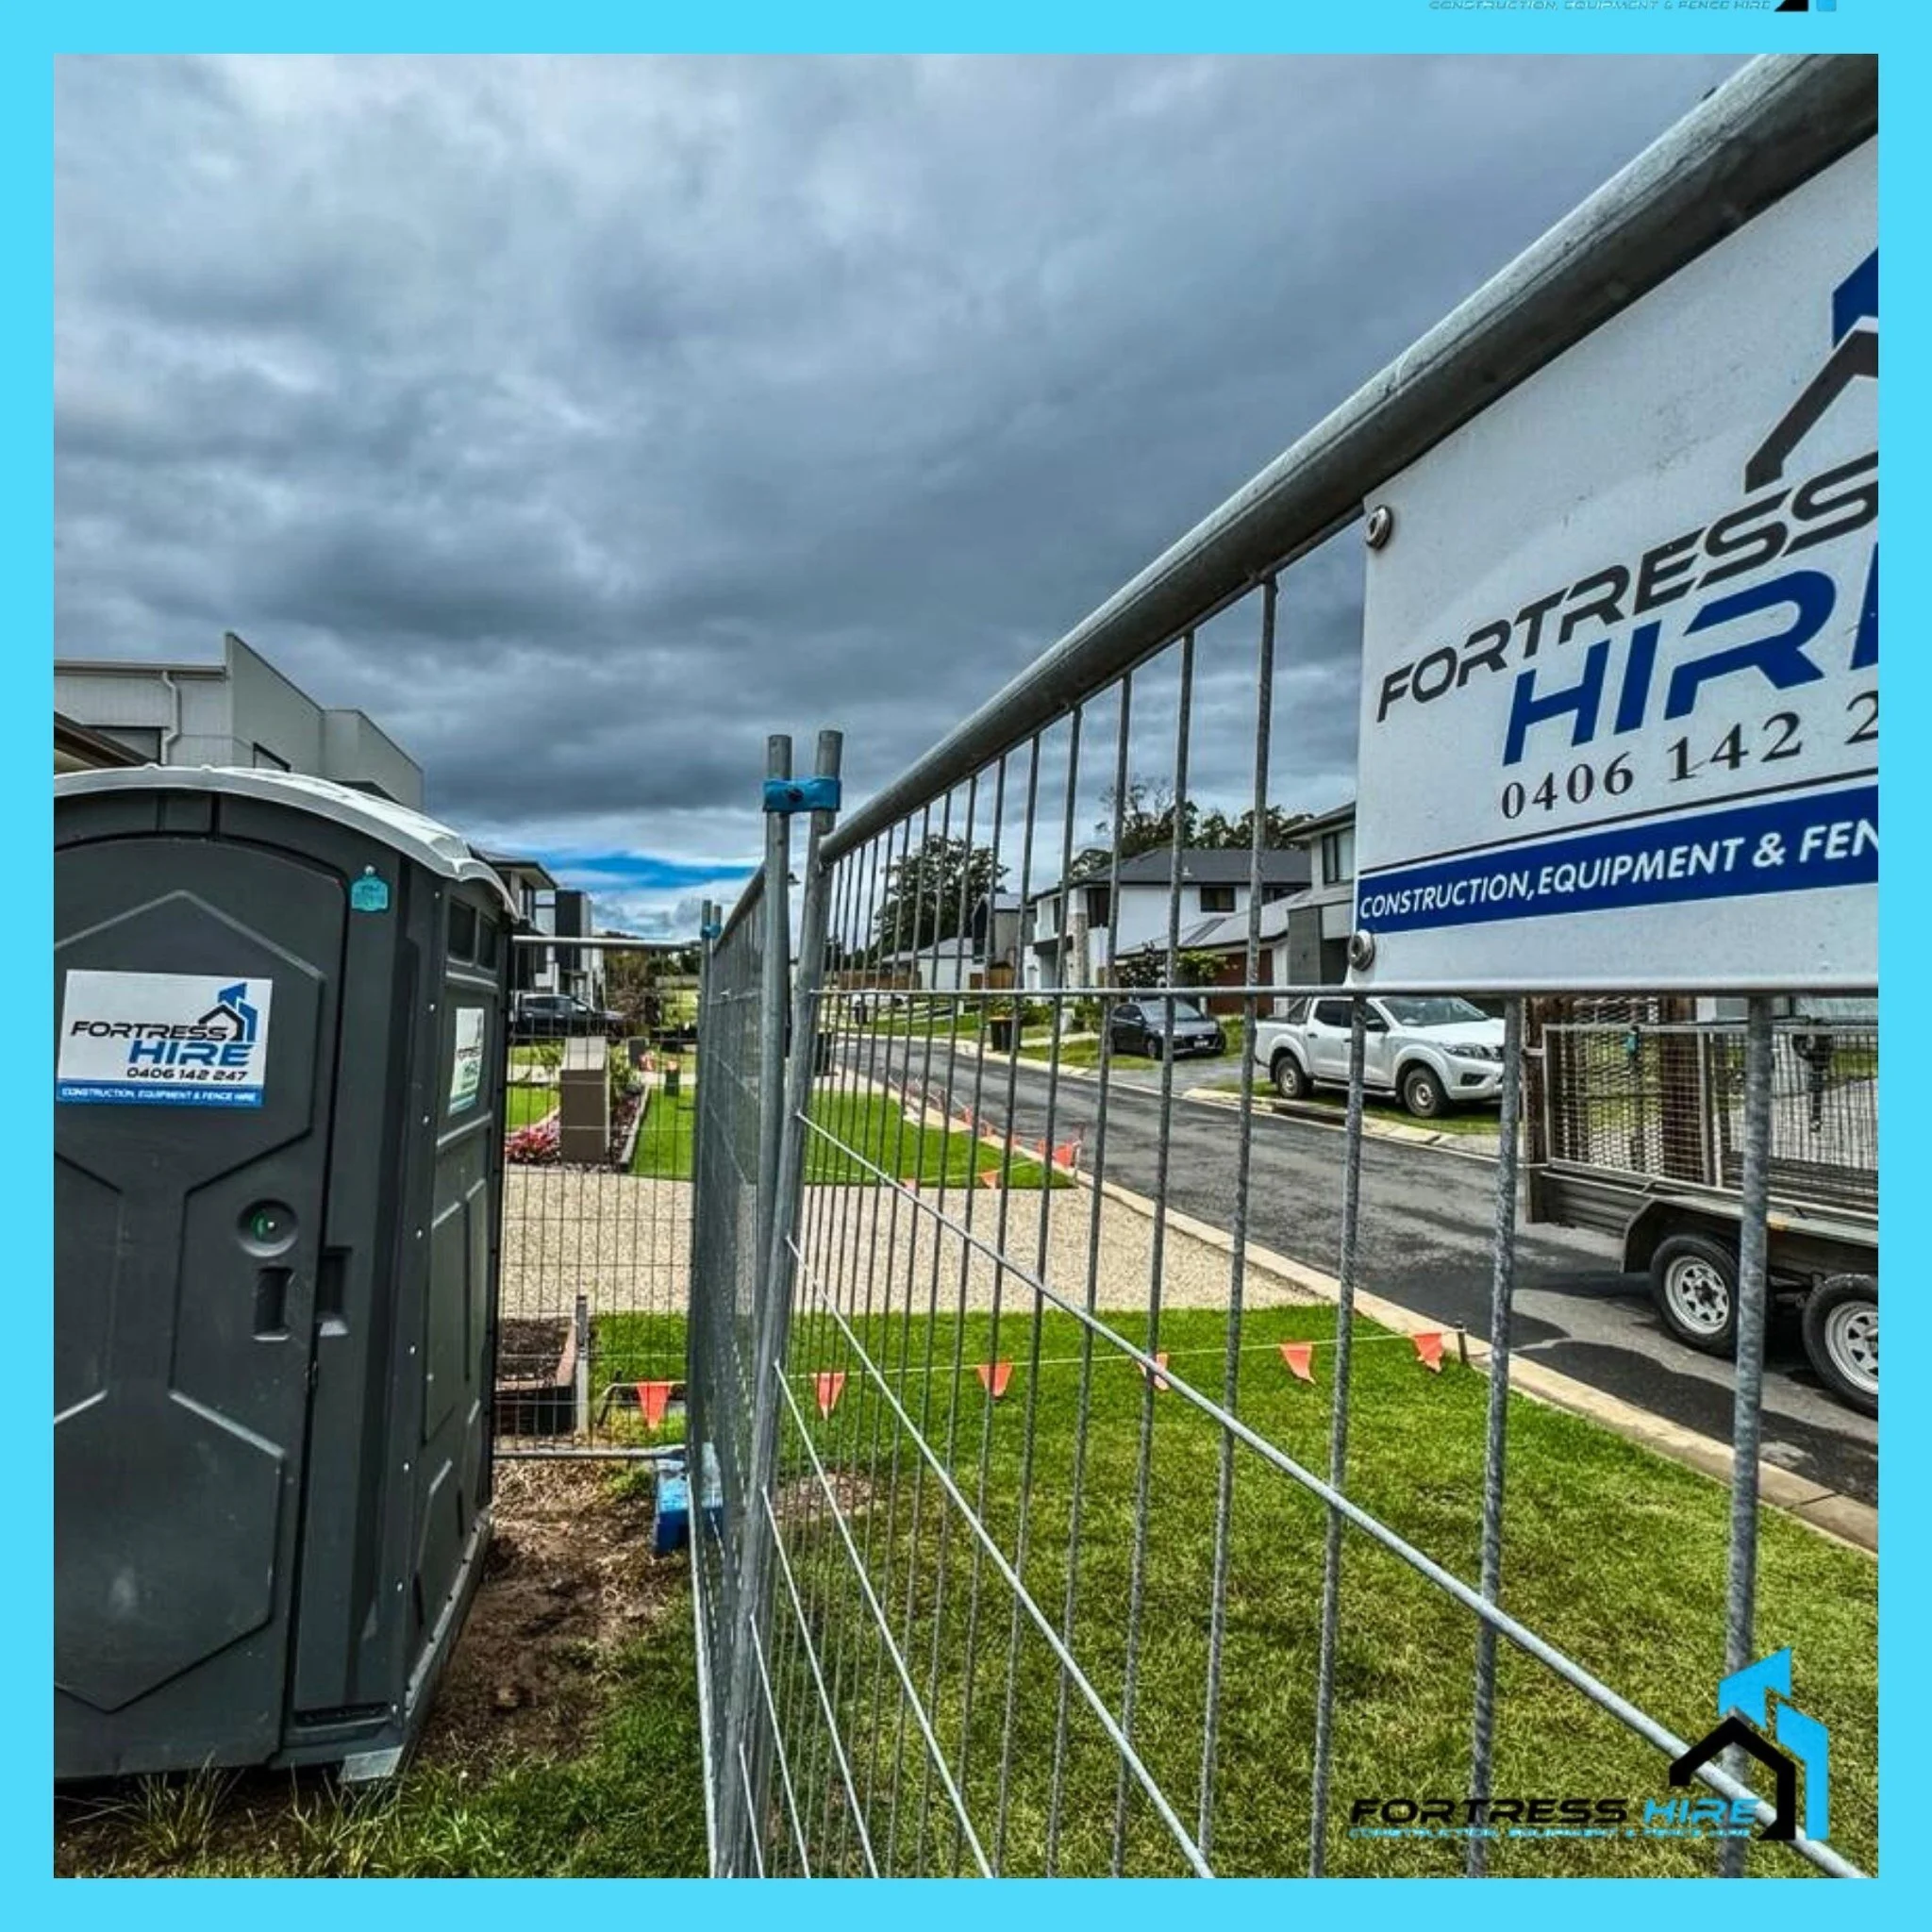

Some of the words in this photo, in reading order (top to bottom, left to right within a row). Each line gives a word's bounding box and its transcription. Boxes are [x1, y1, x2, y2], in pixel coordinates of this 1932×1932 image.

[1376, 451, 1878, 724] FORTRESS
[1501, 751, 1635, 820] 0406
[1668, 710, 1803, 782] 142
[1752, 831, 1786, 868] &
[71, 1021, 227, 1041] FORTRESS
[127, 1040, 254, 1067] HIRE
[126, 1067, 175, 1079] 0406
[178, 1068, 209, 1081] 142
